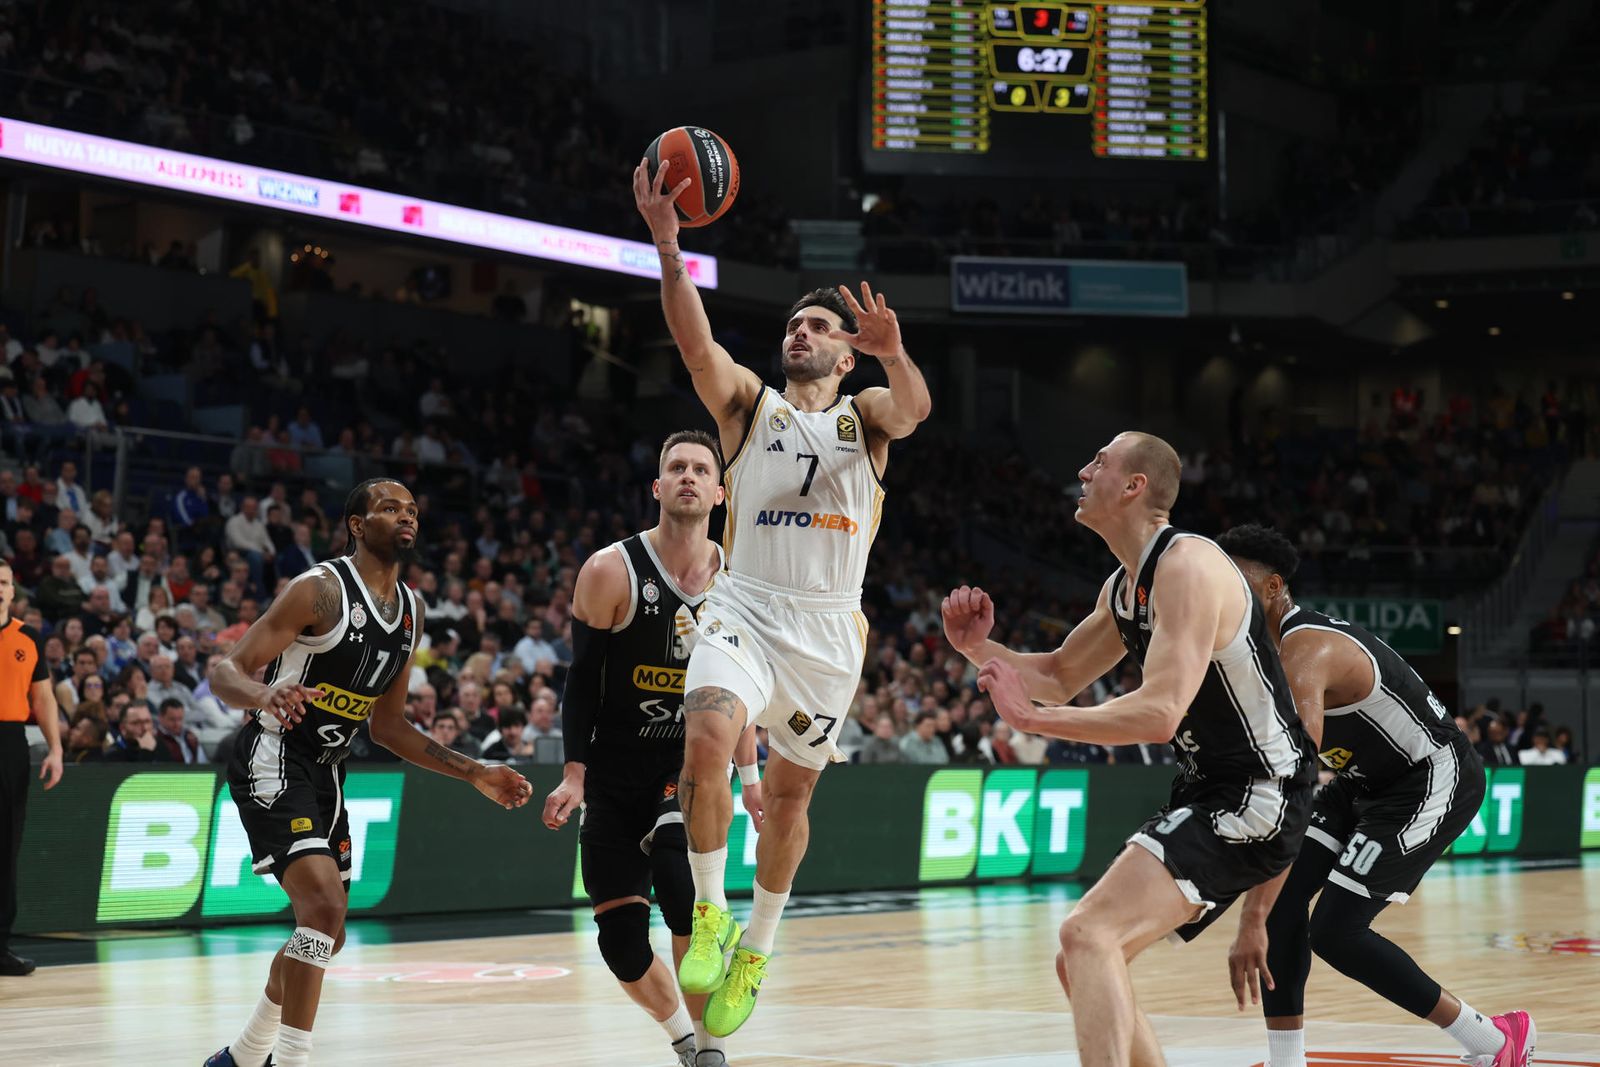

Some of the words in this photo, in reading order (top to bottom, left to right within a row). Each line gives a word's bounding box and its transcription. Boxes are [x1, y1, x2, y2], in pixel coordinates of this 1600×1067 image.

[1033, 9, 1050, 28] 3
[1017, 47, 1073, 73] 6:27
[1054, 88, 1070, 108] 3
[796, 453, 820, 497] 7
[756, 510, 859, 537] AUTOHERO
[366, 650, 391, 688] 7
[808, 713, 837, 748] 7
[925, 789, 1084, 859] BKT
[1338, 831, 1384, 877] 50
